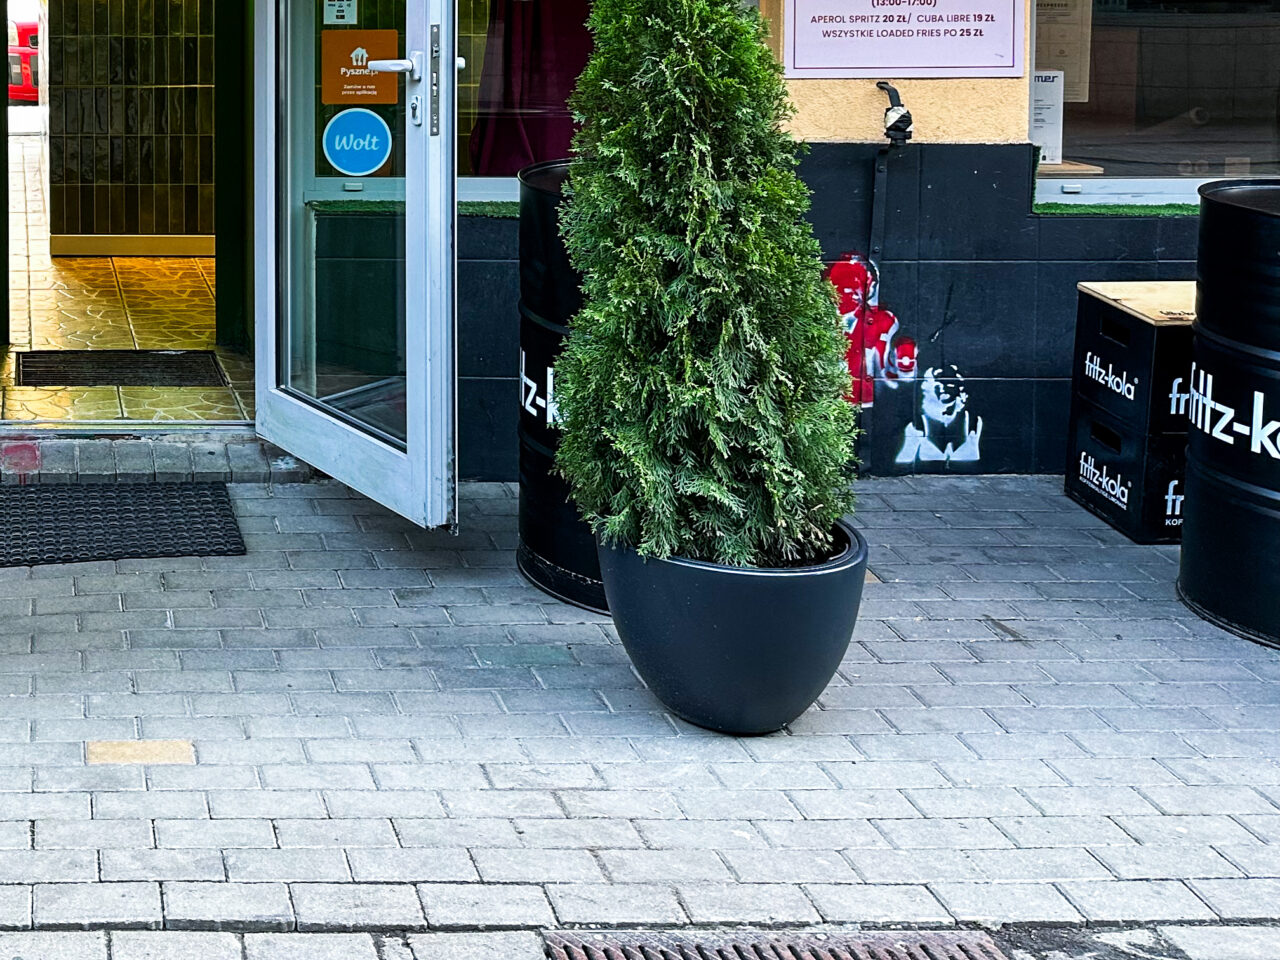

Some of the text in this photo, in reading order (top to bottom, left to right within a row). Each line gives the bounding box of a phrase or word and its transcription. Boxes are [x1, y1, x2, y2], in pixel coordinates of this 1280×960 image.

[849, 15, 880, 23] SPRITZ
[973, 14, 983, 22] 19
[334, 133, 380, 151] Wolt
[1085, 351, 1135, 401] fritz-kola
[1188, 361, 1280, 460] fritz-k
[1080, 451, 1128, 504] fritz-kola
